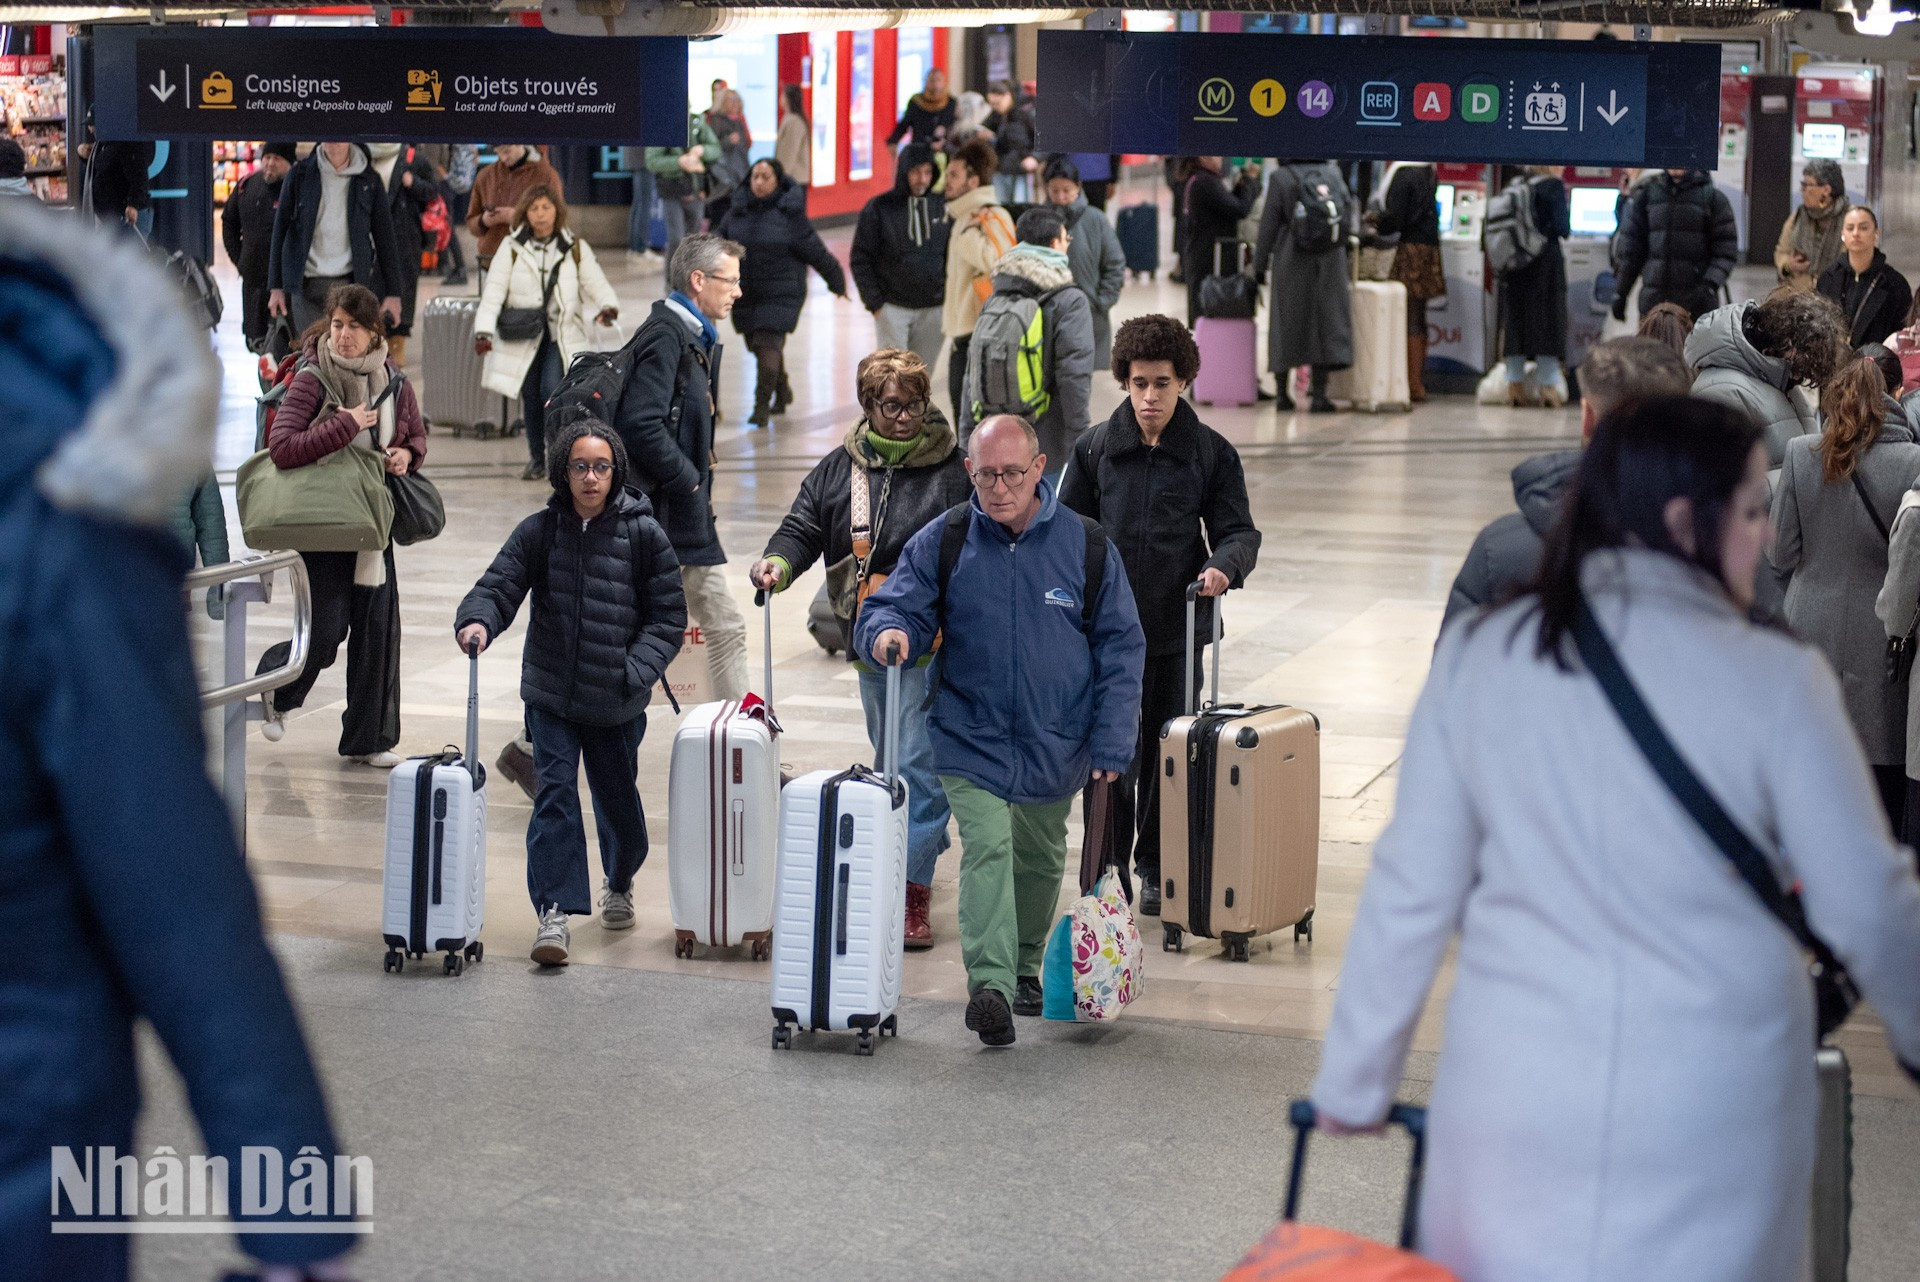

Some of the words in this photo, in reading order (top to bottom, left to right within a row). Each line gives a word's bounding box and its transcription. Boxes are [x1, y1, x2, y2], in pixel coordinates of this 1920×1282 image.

[246, 74, 341, 98] Consignes
[454, 75, 519, 99] Objets
[524, 76, 598, 96] trouvés
[246, 100, 265, 110] Left
[266, 99, 304, 113] luggage
[312, 100, 356, 112] Deposito
[357, 100, 393, 113] bagagli
[454, 101, 477, 112] Lost
[478, 101, 498, 112] and
[499, 101, 528, 113] found
[537, 101, 575, 115] Oggetti
[576, 102, 616, 113] smarriti
[1206, 86, 1228, 107] M
[1261, 87, 1273, 108] 1
[1301, 88, 1329, 110] 14
[1366, 92, 1393, 109] RER
[1422, 91, 1441, 113] A
[1472, 93, 1491, 114] D
[601, 145, 624, 171] H
[657, 683, 697, 692] COCOLAT
